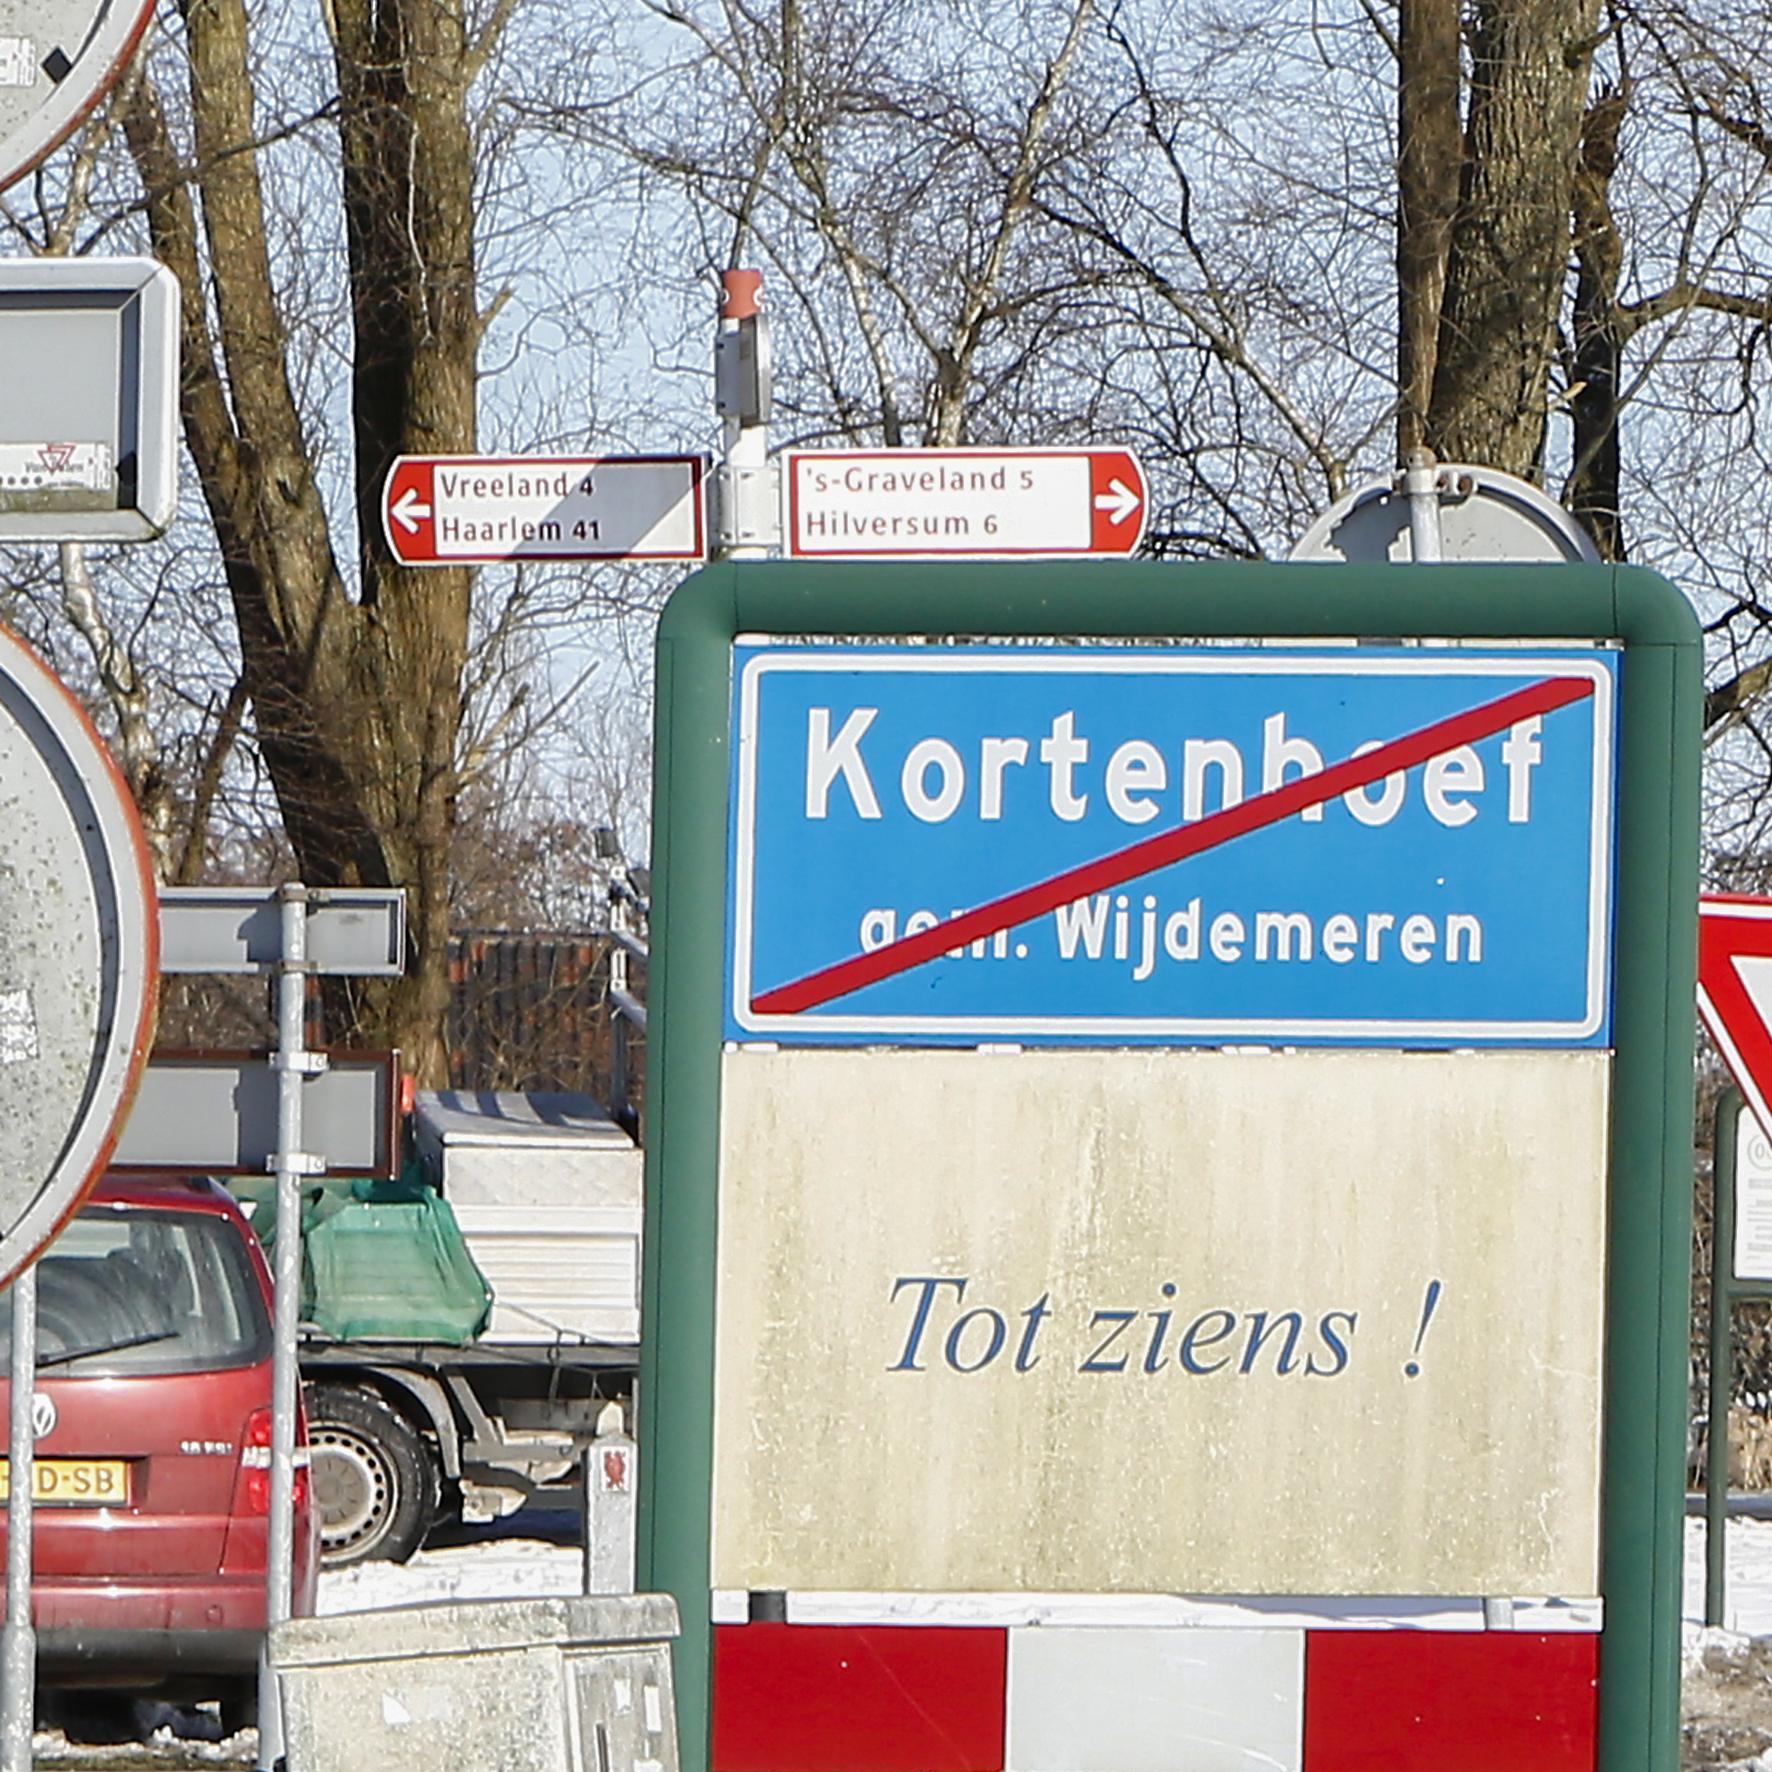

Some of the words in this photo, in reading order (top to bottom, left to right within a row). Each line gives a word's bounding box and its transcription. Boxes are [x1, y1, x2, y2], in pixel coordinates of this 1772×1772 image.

[440, 472, 568, 498] Vreeland
[580, 475, 594, 495] 4
[806, 466, 1006, 492] 's-Graveland
[1020, 470, 1034, 490] 5
[441, 517, 562, 541] Haarlem
[572, 519, 600, 541] 41
[806, 511, 970, 535] Hilversum
[983, 513, 999, 535] 6
[804, 707, 1543, 829] Kortenhoef
[1054, 893, 1484, 981] Wijdemeren
[885, 1275, 1051, 1374] Tot
[1077, 1281, 1359, 1378] ziens
[1402, 1278, 1442, 1378] !
